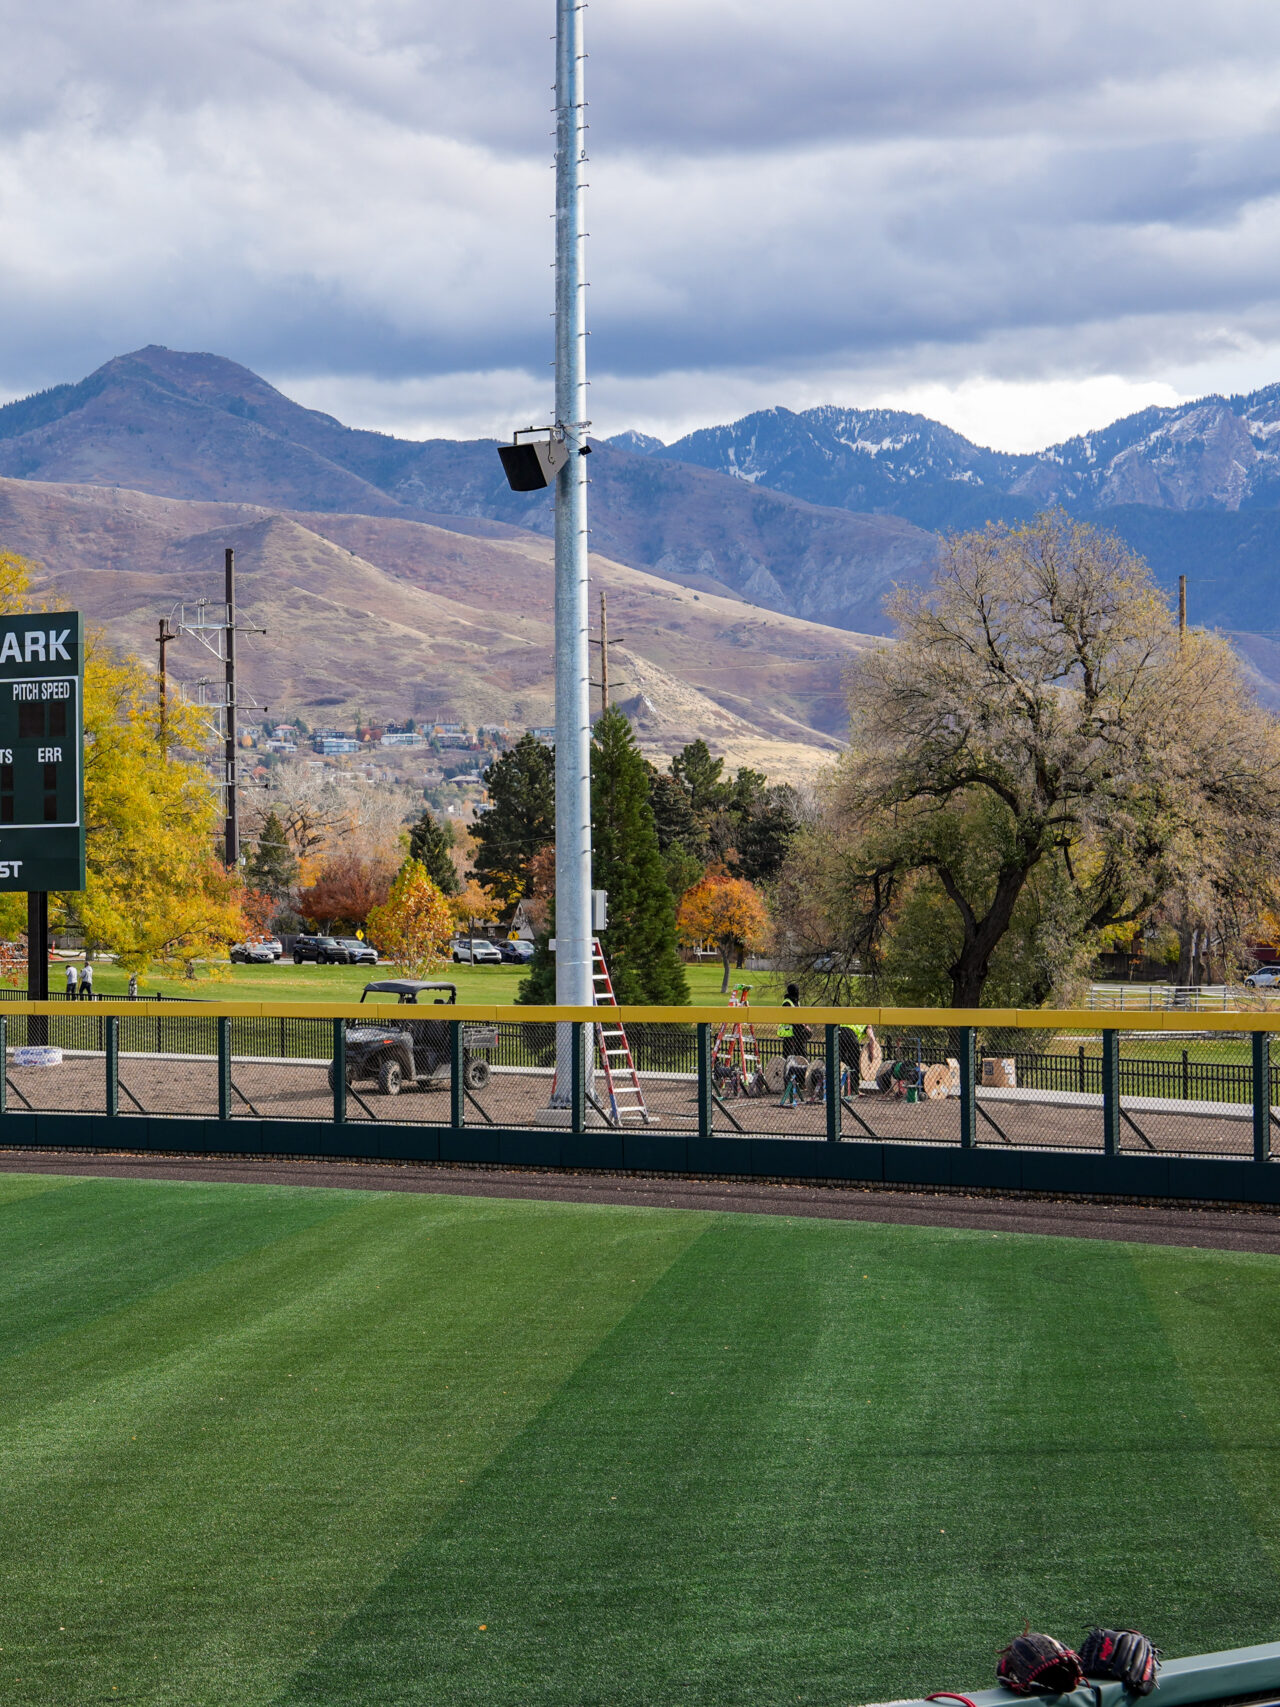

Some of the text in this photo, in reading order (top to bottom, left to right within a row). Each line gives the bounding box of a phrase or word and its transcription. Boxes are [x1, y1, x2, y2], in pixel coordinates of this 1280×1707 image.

[13, 682, 69, 700] PITCH SPEED
[38, 747, 62, 762] ERR
